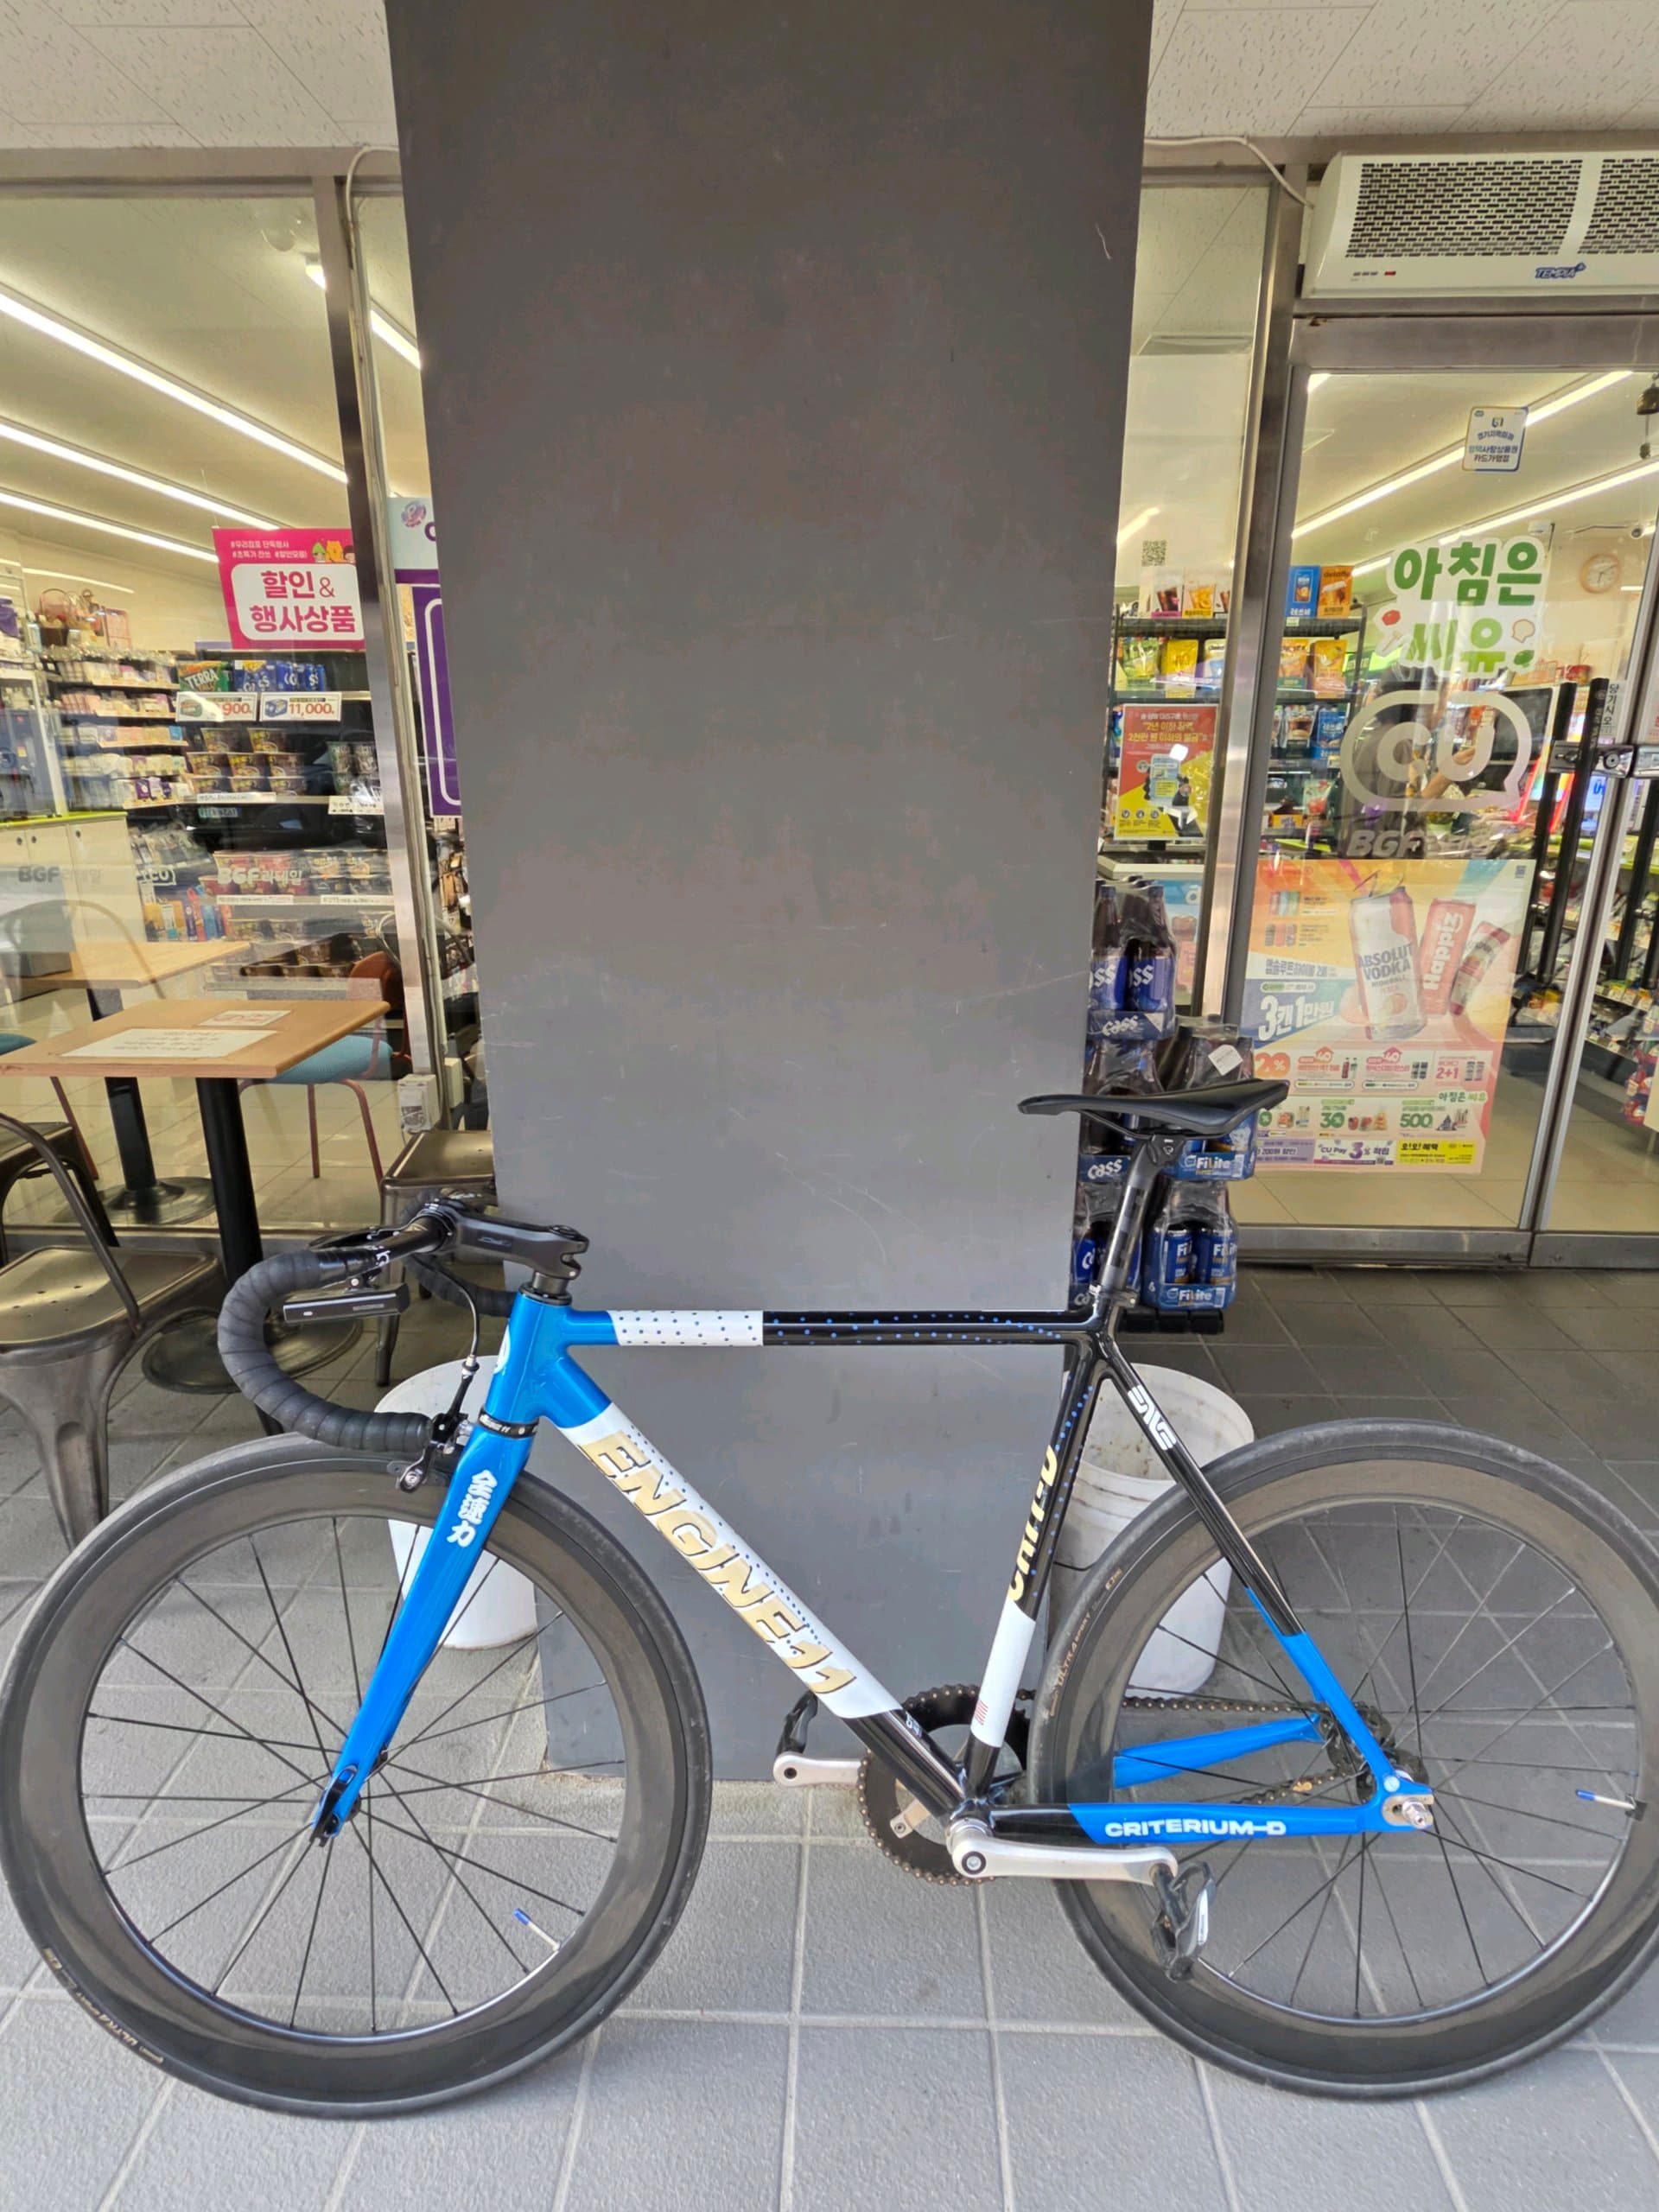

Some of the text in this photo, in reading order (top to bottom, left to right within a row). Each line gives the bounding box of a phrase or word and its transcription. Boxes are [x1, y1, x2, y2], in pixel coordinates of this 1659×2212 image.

[261, 570, 335, 599] 할인 &
[1394, 542, 1542, 607] 아침은
[250, 605, 356, 632] 행사상품
[1405, 618, 1507, 674] 씨유
[185, 669, 219, 689] TERRA
[1602, 684, 1619, 725] 당기시오
[1376, 721, 1495, 782] CU
[1358, 943, 1413, 969] ABSOLUT
[1363, 958, 1411, 981] VODKA
[1436, 1067, 1459, 1079] 2+1
[1439, 1091, 1465, 1103] 아침은
[446, 1469, 498, 1548] 全速力
[1104, 1819, 1287, 1838] CRITERIUM-D
